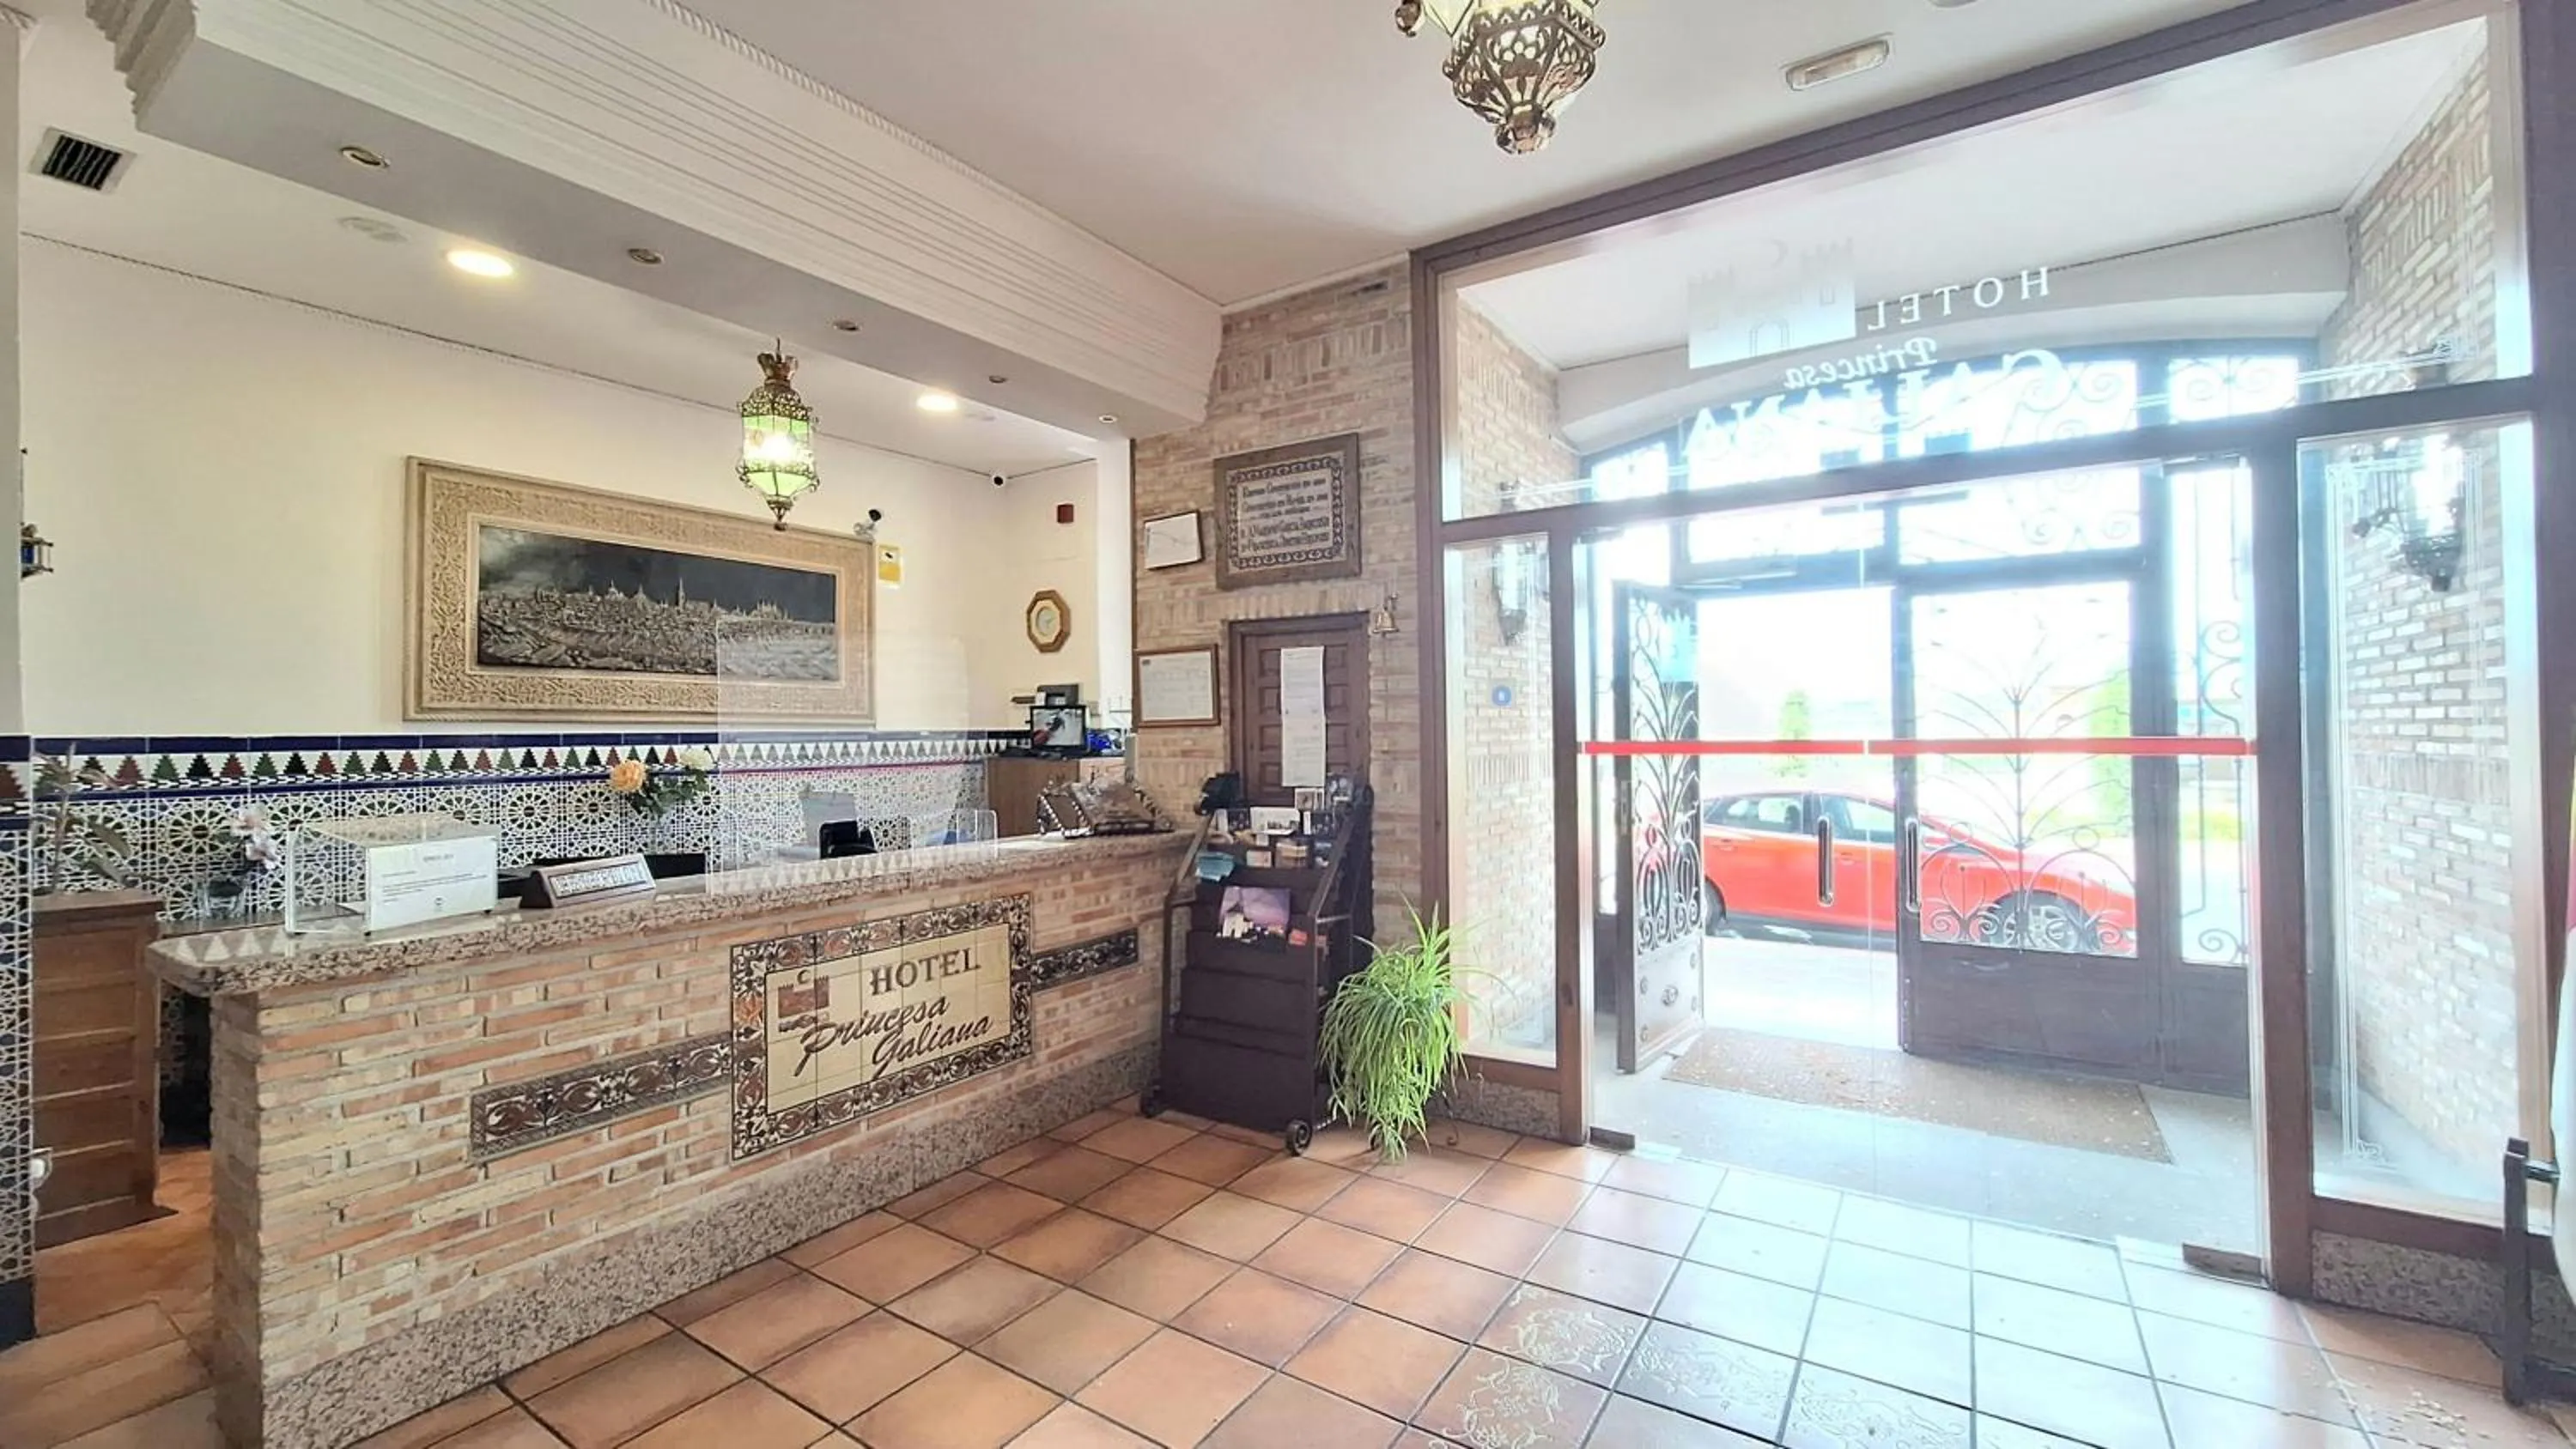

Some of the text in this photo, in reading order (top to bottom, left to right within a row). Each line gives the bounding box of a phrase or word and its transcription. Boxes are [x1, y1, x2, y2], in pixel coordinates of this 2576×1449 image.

[869, 947, 981, 996] HOTEL
[793, 996, 950, 1076] Princesa
[872, 1016, 993, 1079] Galiana
